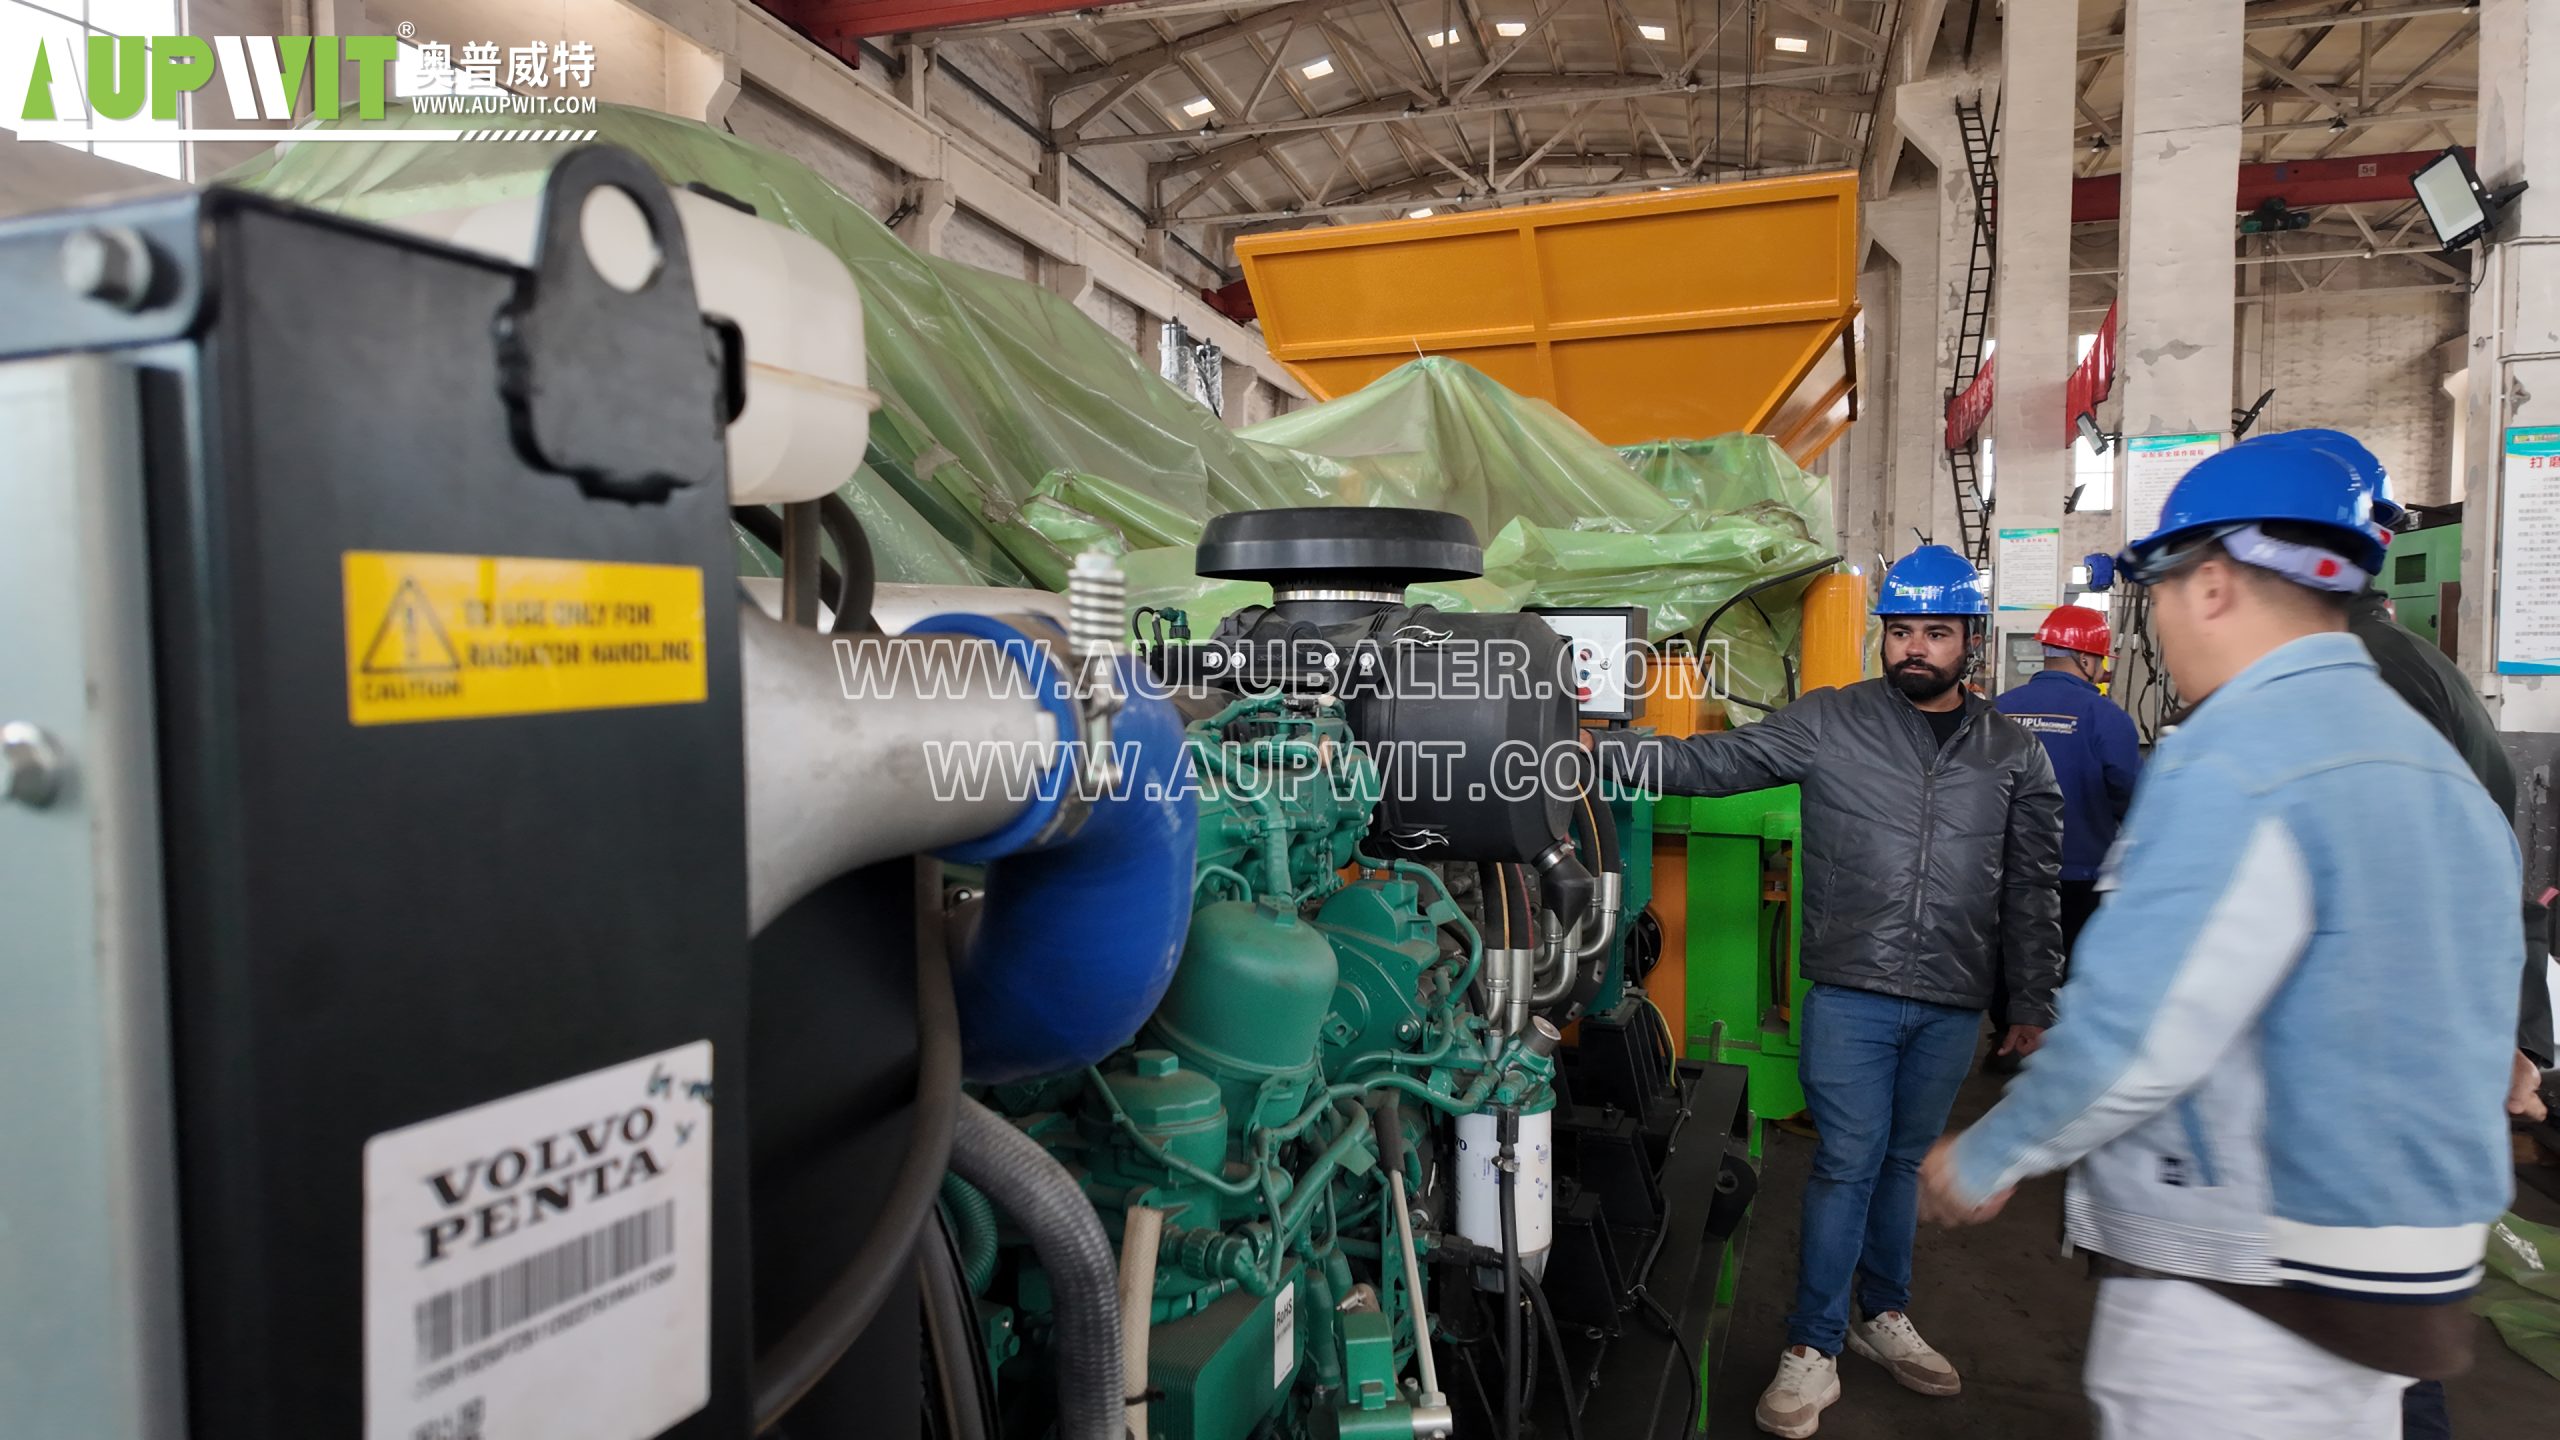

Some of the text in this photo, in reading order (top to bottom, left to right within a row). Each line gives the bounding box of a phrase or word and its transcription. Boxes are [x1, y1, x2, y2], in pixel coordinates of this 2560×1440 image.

[613, 602, 655, 627] FOR
[466, 638, 694, 668] RADIATOR HANDLING
[360, 679, 463, 702] CAUTION
[421, 1104, 657, 1210] VOLVO
[418, 1146, 664, 1268] PENTA
